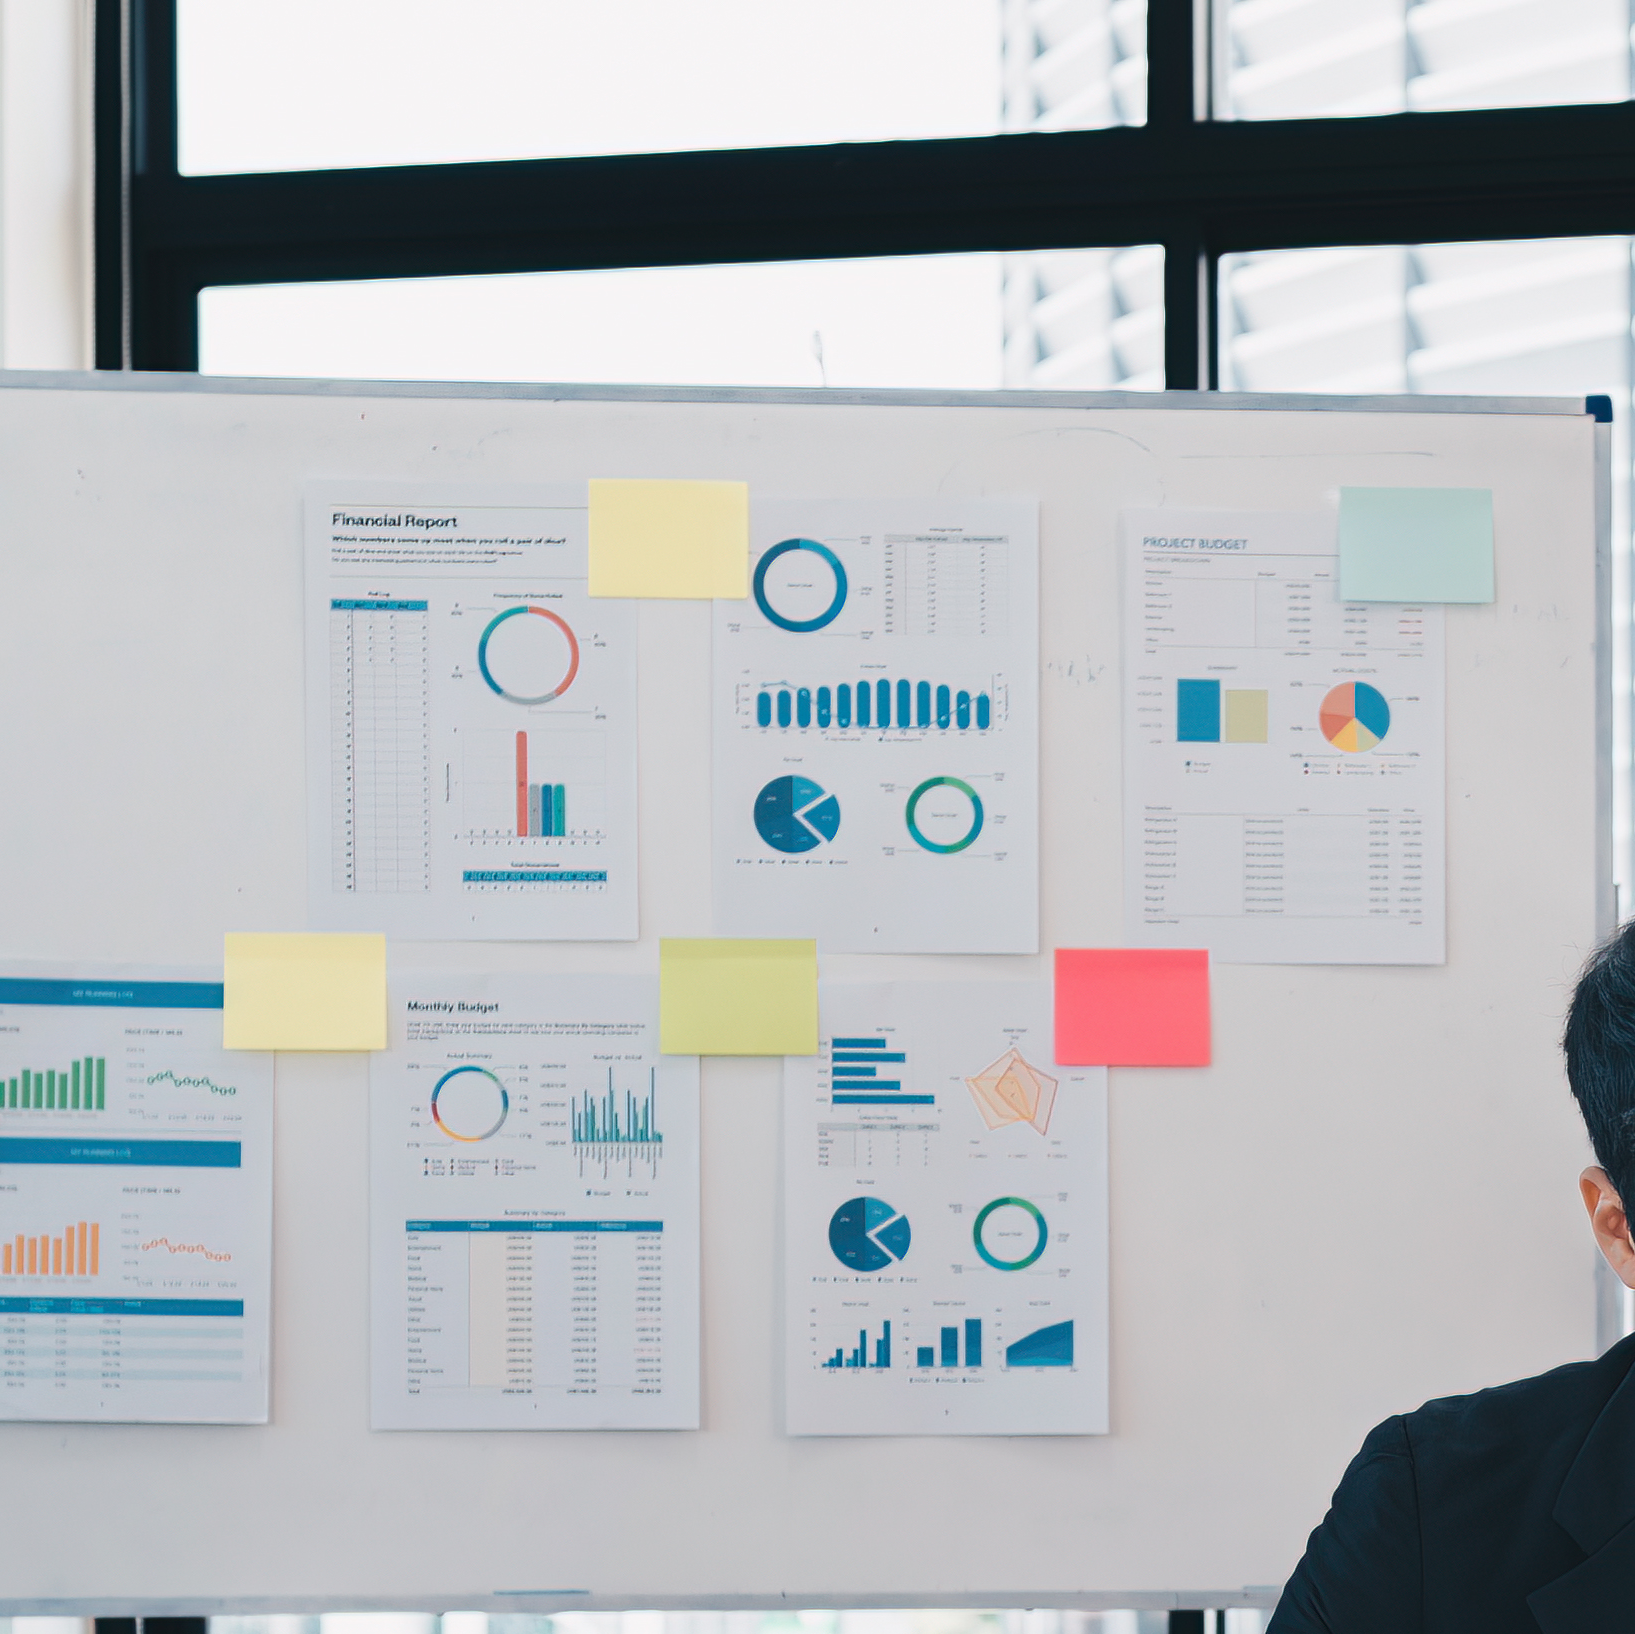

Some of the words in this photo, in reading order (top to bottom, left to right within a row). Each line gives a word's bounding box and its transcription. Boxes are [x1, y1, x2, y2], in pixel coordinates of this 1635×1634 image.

[332, 512, 402, 528] Financial
[405, 514, 458, 531] Report
[1143, 537, 1196, 550] PROJECT
[1198, 538, 1248, 551] BUDGET
[407, 999, 454, 1014] Monthly
[457, 1001, 499, 1015] Budget
